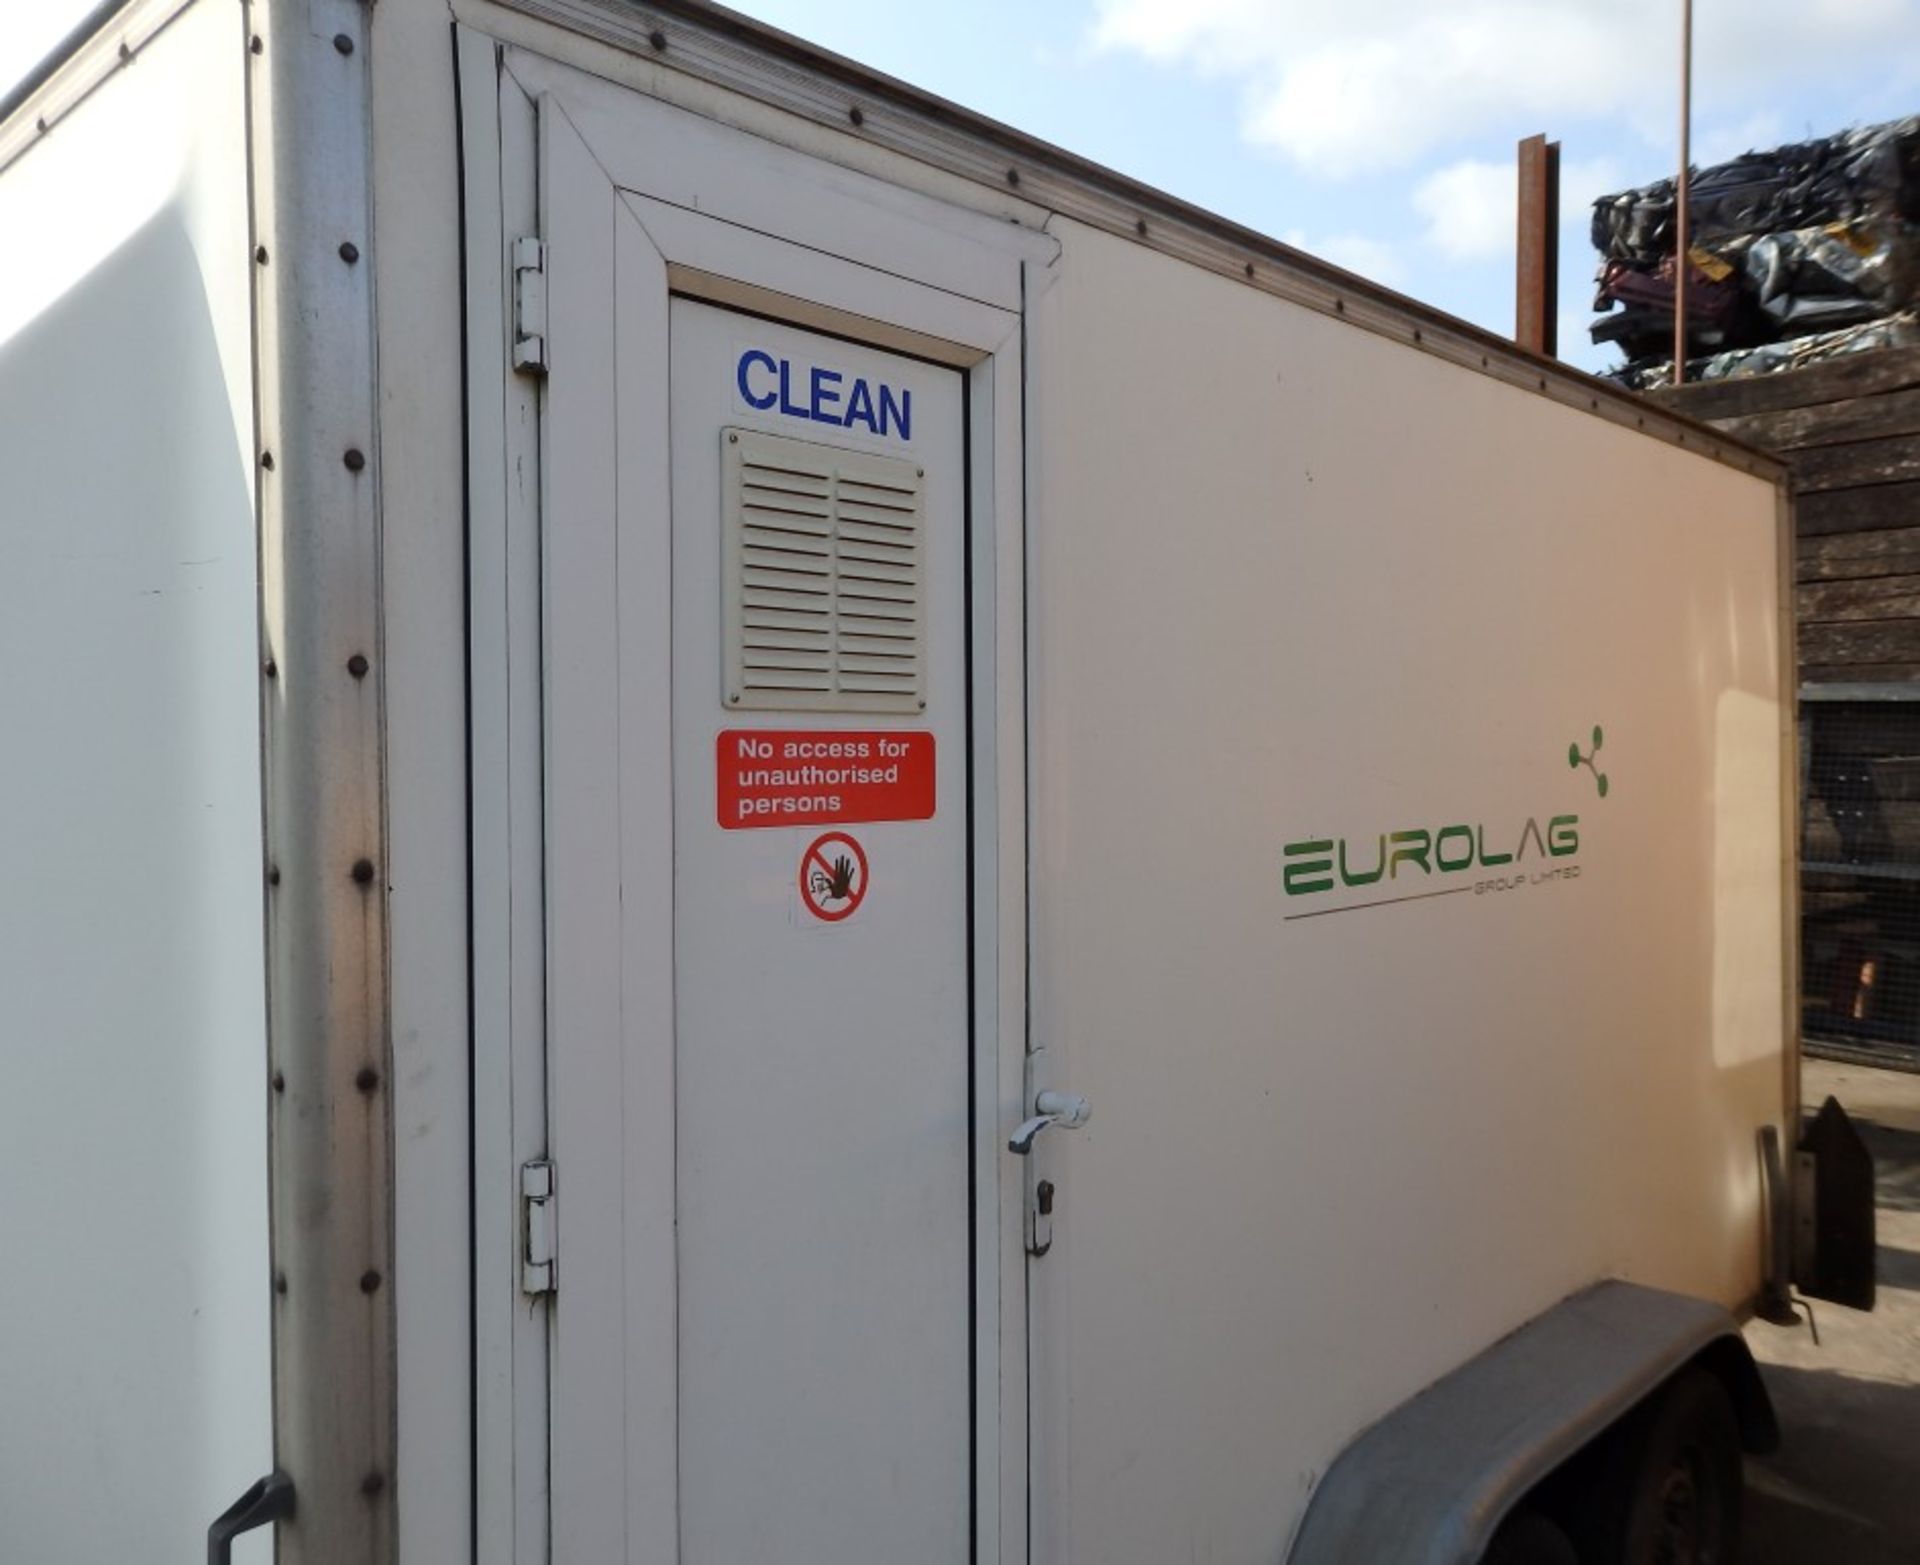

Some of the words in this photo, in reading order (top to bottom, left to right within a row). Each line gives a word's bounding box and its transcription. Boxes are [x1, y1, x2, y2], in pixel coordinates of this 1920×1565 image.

[737, 349, 911, 441] CLEAN
[738, 739, 773, 758] No
[784, 742, 870, 758] access
[878, 739, 910, 757] for
[738, 765, 898, 786] unauthorised
[738, 795, 842, 819] persons
[1284, 815, 1578, 895] EUROLAG
[1474, 875, 1525, 896] GROUP
[1531, 865, 1581, 886] LIMITED
